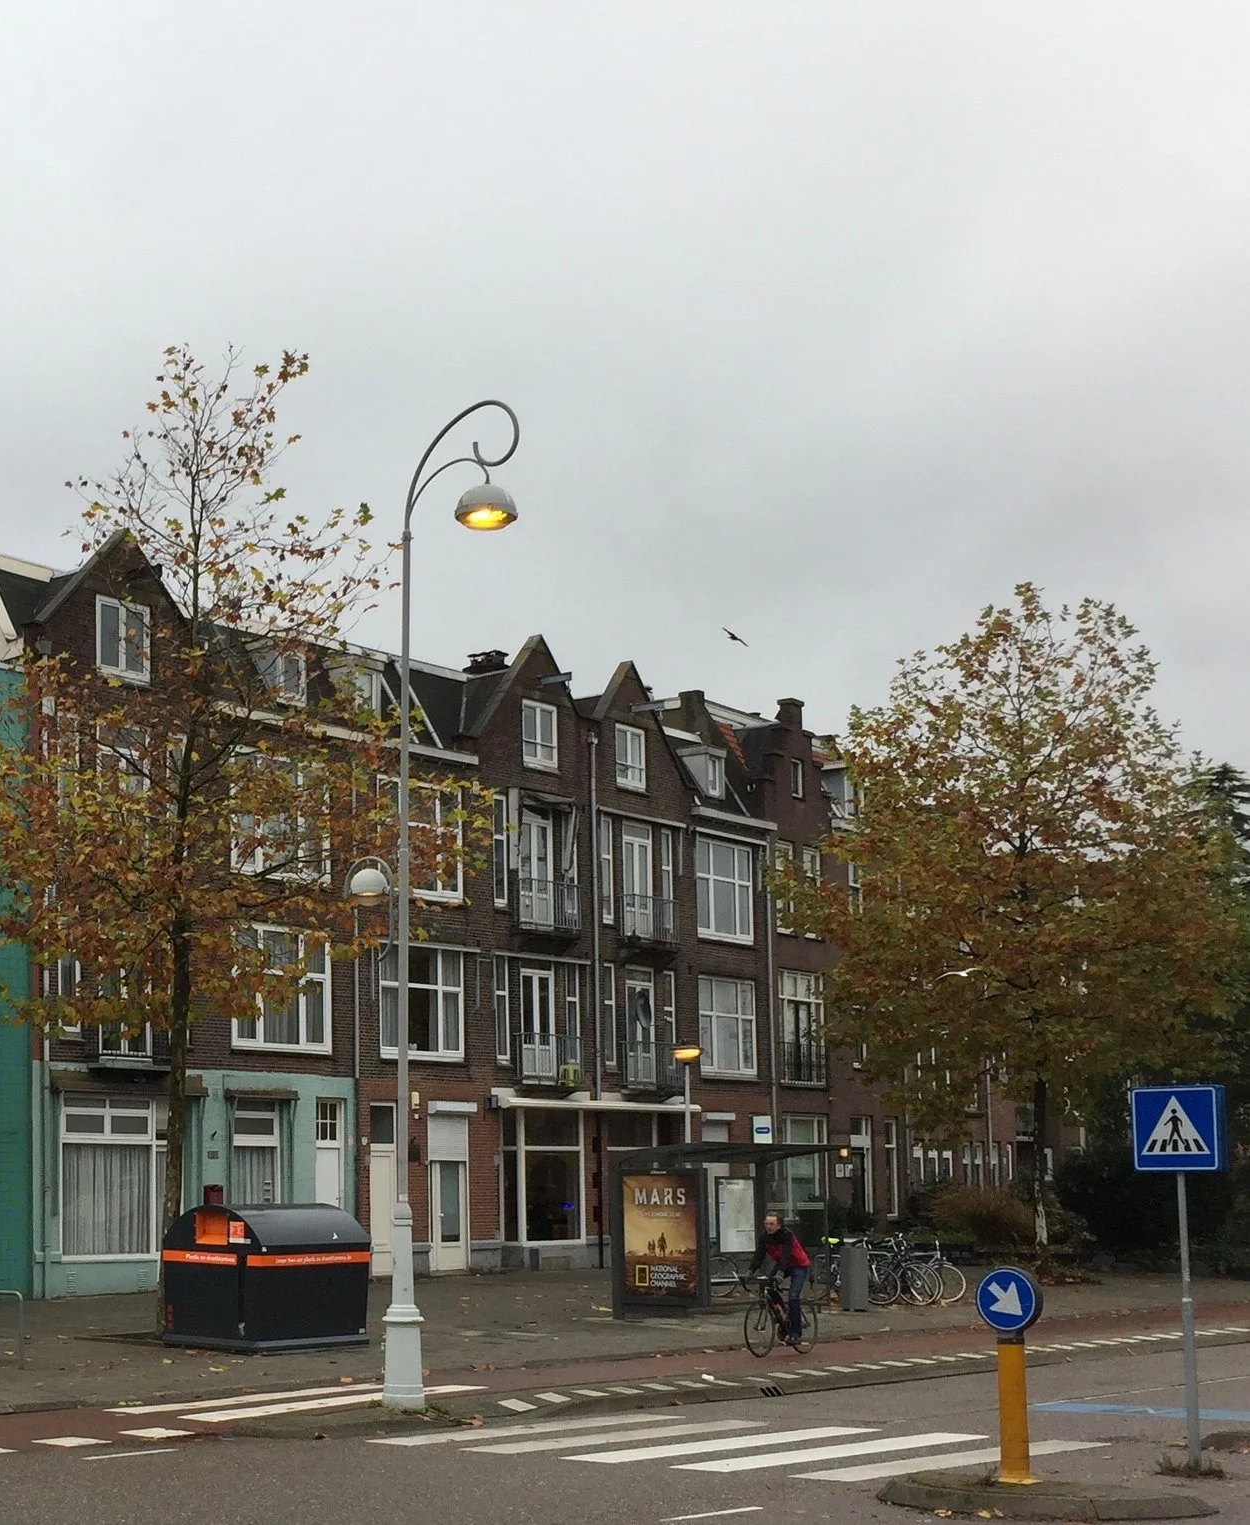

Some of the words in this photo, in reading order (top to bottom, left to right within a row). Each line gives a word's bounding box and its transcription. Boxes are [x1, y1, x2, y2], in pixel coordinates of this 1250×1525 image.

[634, 1187, 686, 1205] MARS
[650, 1264, 678, 1273] NATIONAL
[650, 1272, 687, 1280] GEOGRAPHIC
